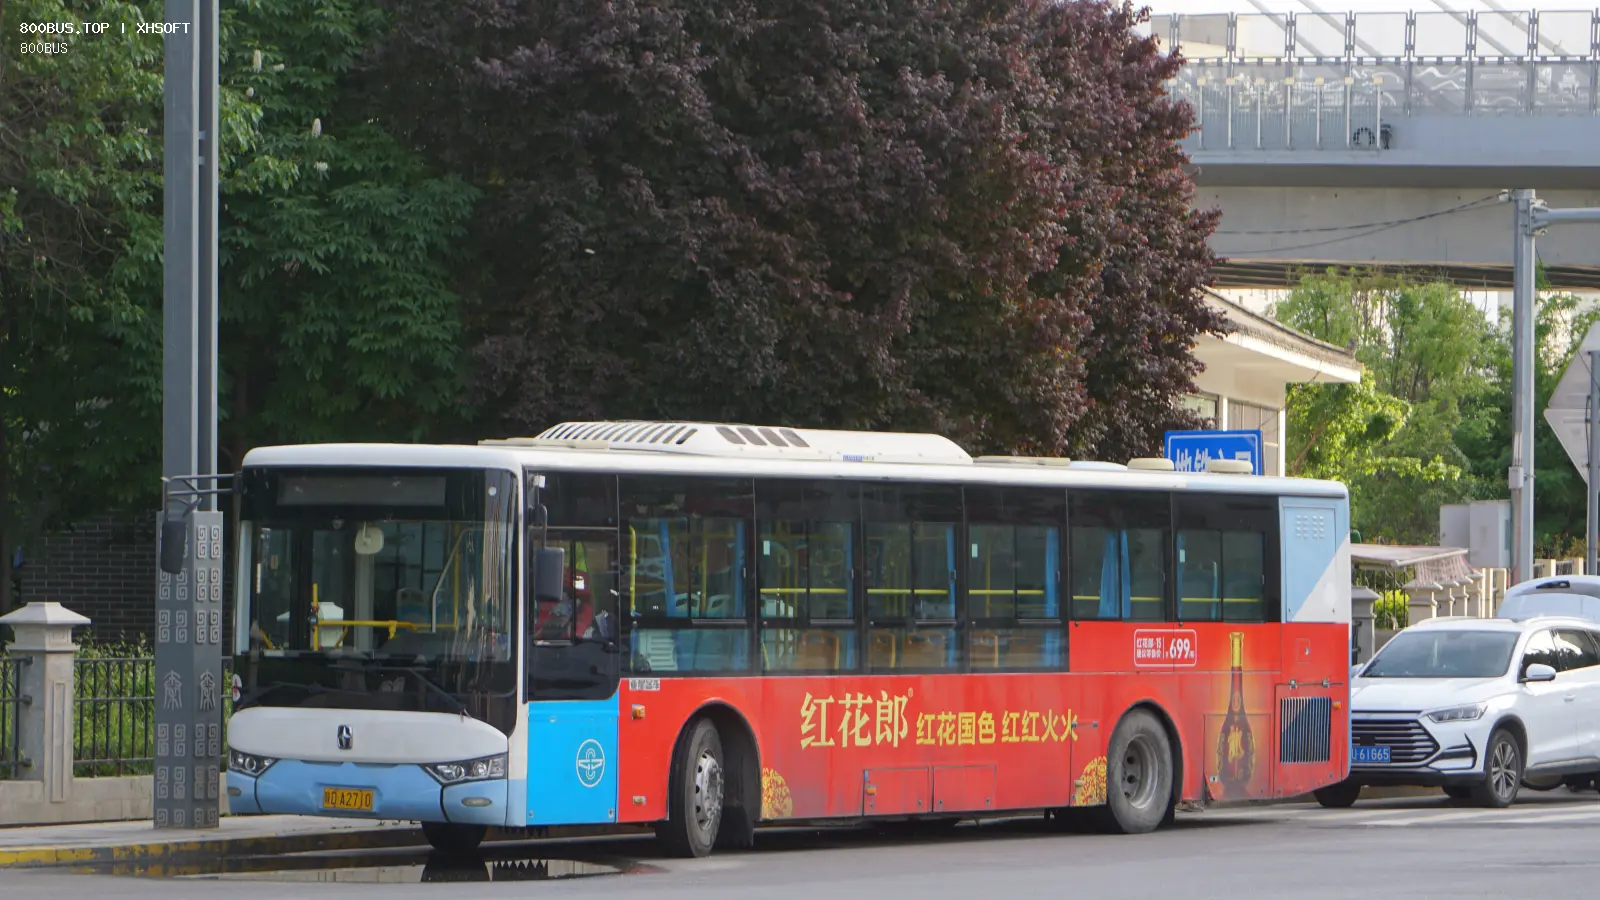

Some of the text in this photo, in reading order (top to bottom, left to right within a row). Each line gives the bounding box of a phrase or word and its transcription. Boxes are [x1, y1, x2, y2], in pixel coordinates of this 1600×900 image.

[800, 690, 1078, 750] 红花郎 红花国色 红红火火
